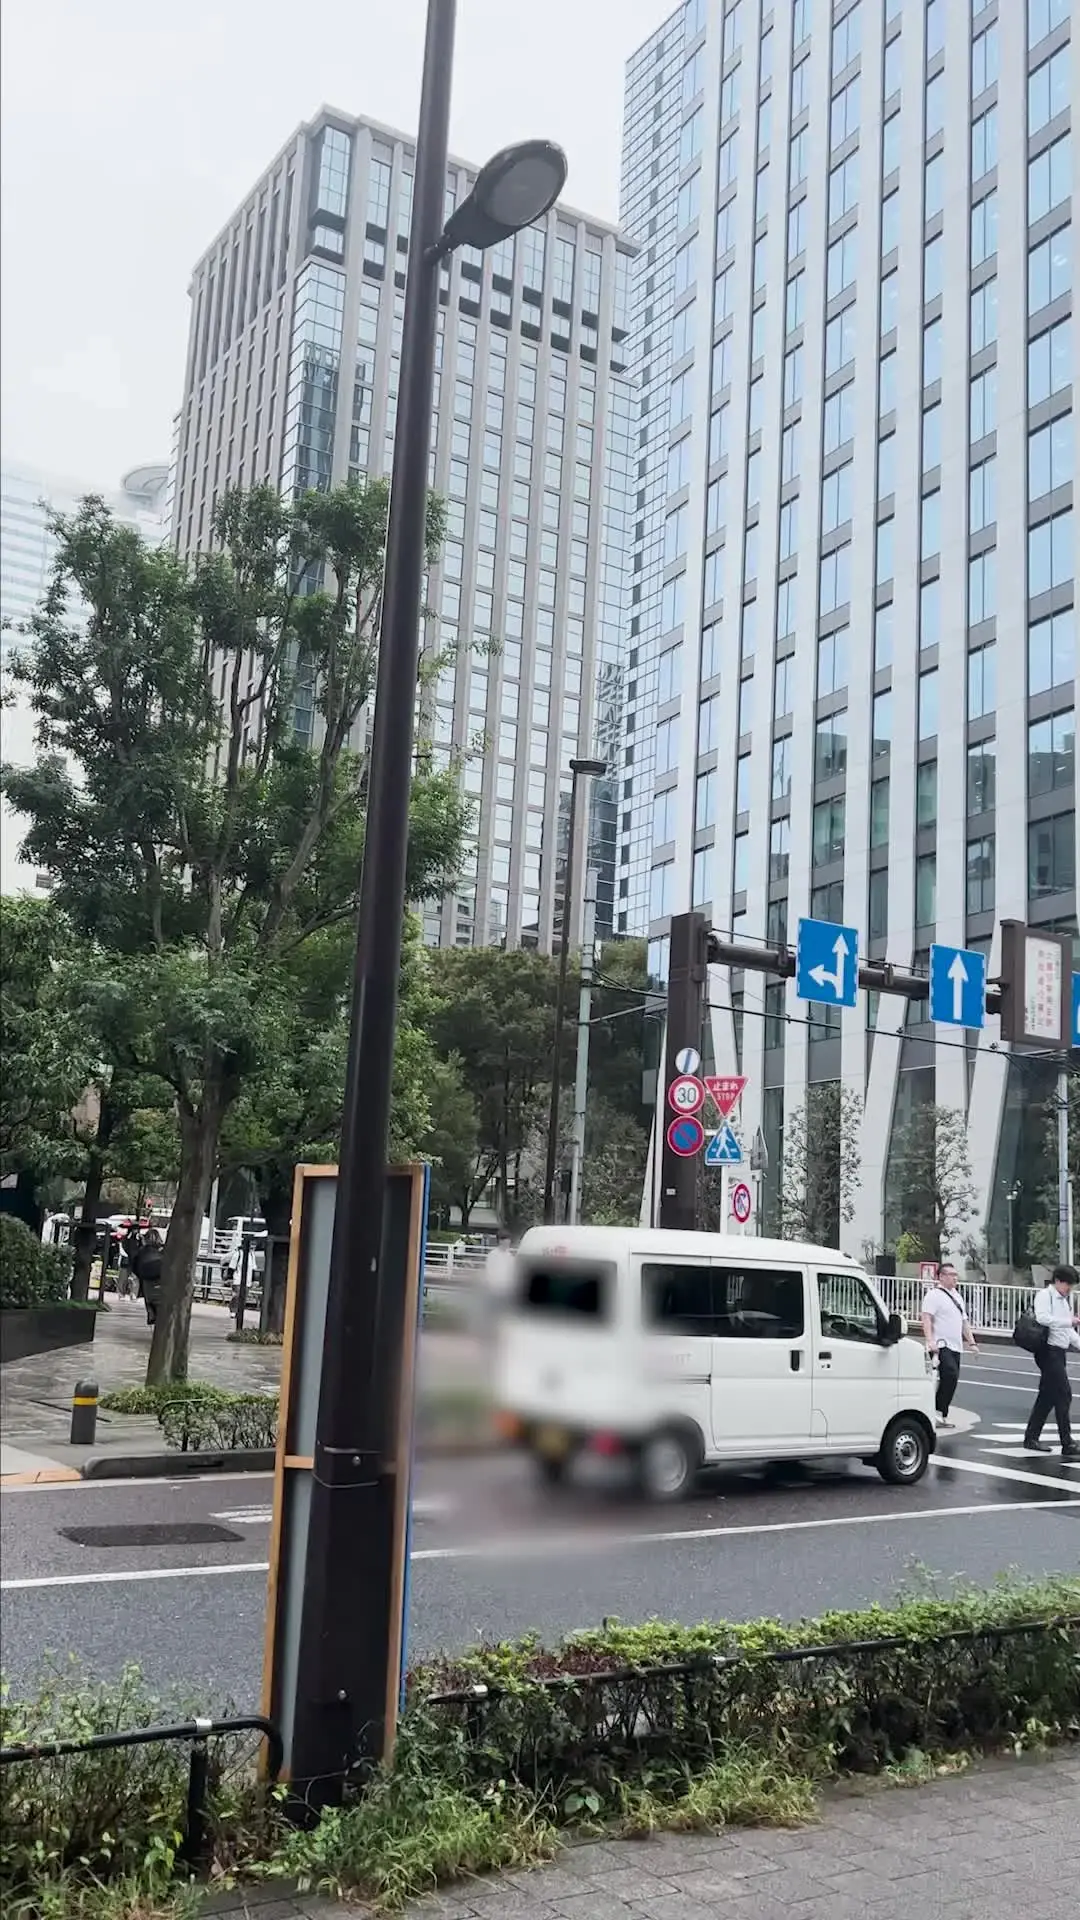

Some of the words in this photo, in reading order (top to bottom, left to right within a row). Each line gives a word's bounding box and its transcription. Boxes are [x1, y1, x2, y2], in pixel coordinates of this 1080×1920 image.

[712, 1081, 738, 1091] 止まれ
[677, 1087, 696, 1103] 30
[716, 1092, 735, 1101] STOP
